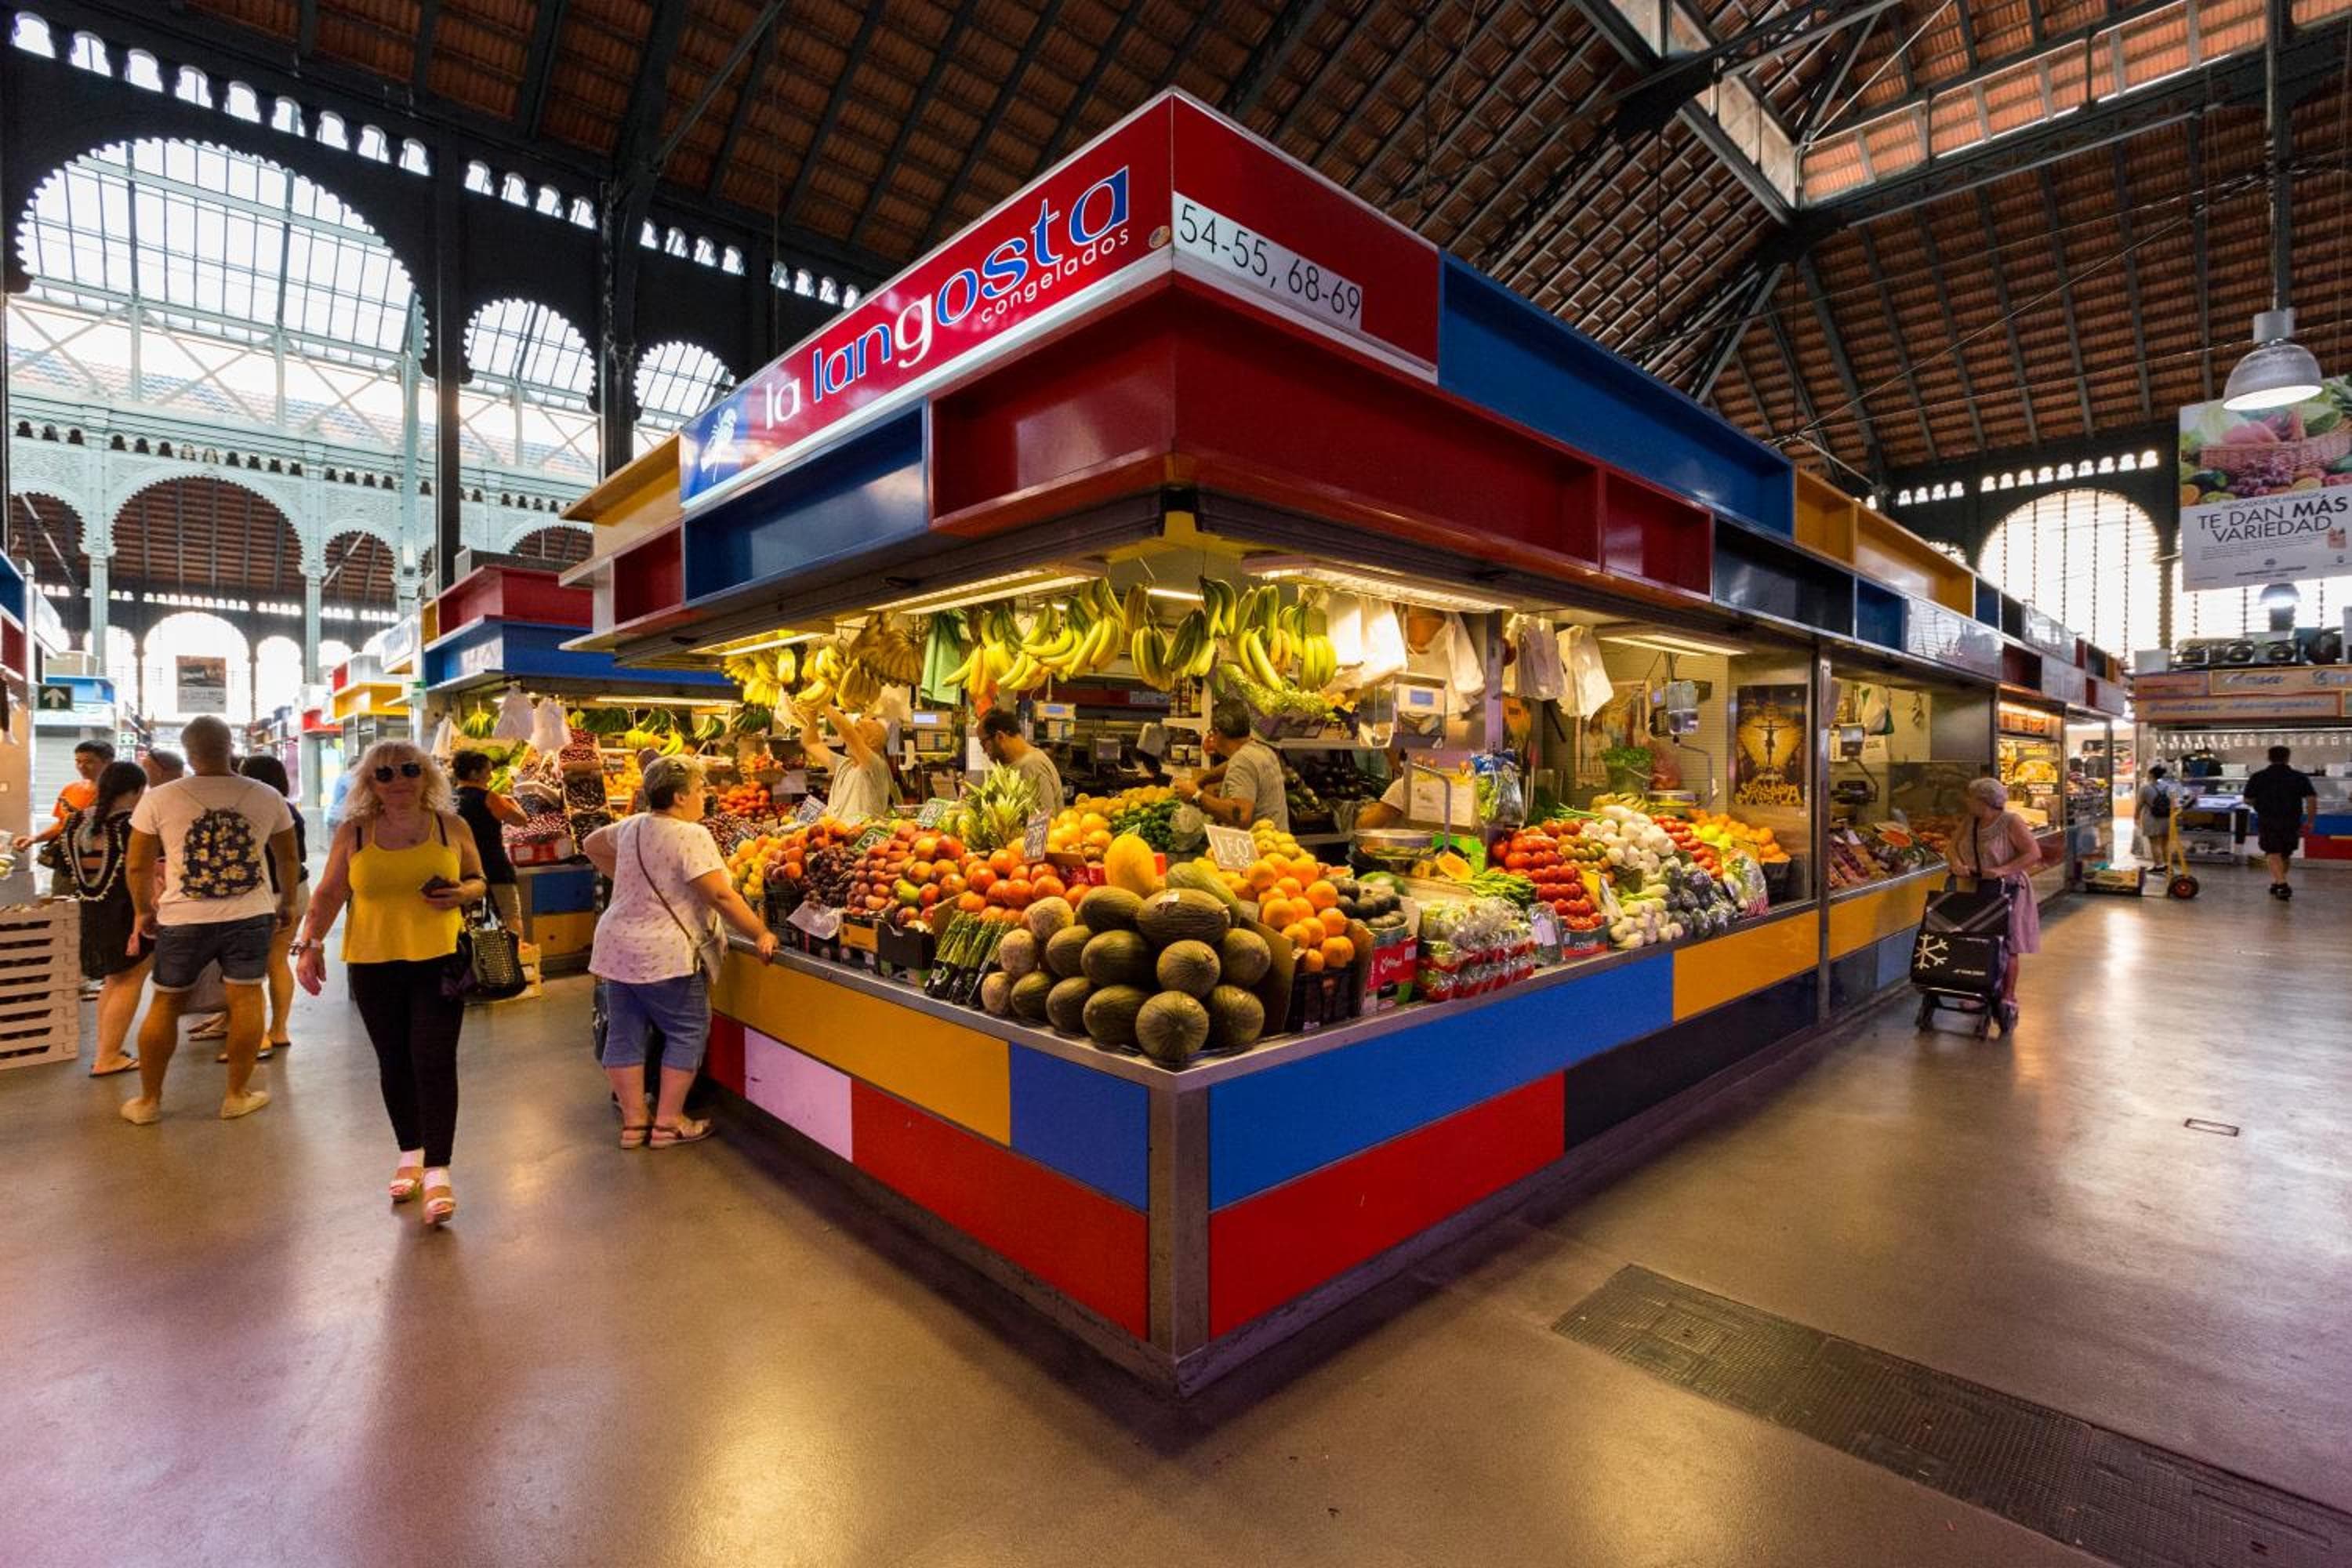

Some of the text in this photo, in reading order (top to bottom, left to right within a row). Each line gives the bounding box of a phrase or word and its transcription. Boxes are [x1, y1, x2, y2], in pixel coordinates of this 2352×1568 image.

[765, 164, 1129, 430] la langosta
[980, 228, 1129, 324] congelados
[1179, 203, 1361, 320] 54-55, 68-69
[2198, 513, 2222, 530] TE
[2229, 506, 2285, 526] DAN
[2292, 494, 2349, 518] MÁS
[2212, 515, 2332, 543] VARIEDAD
